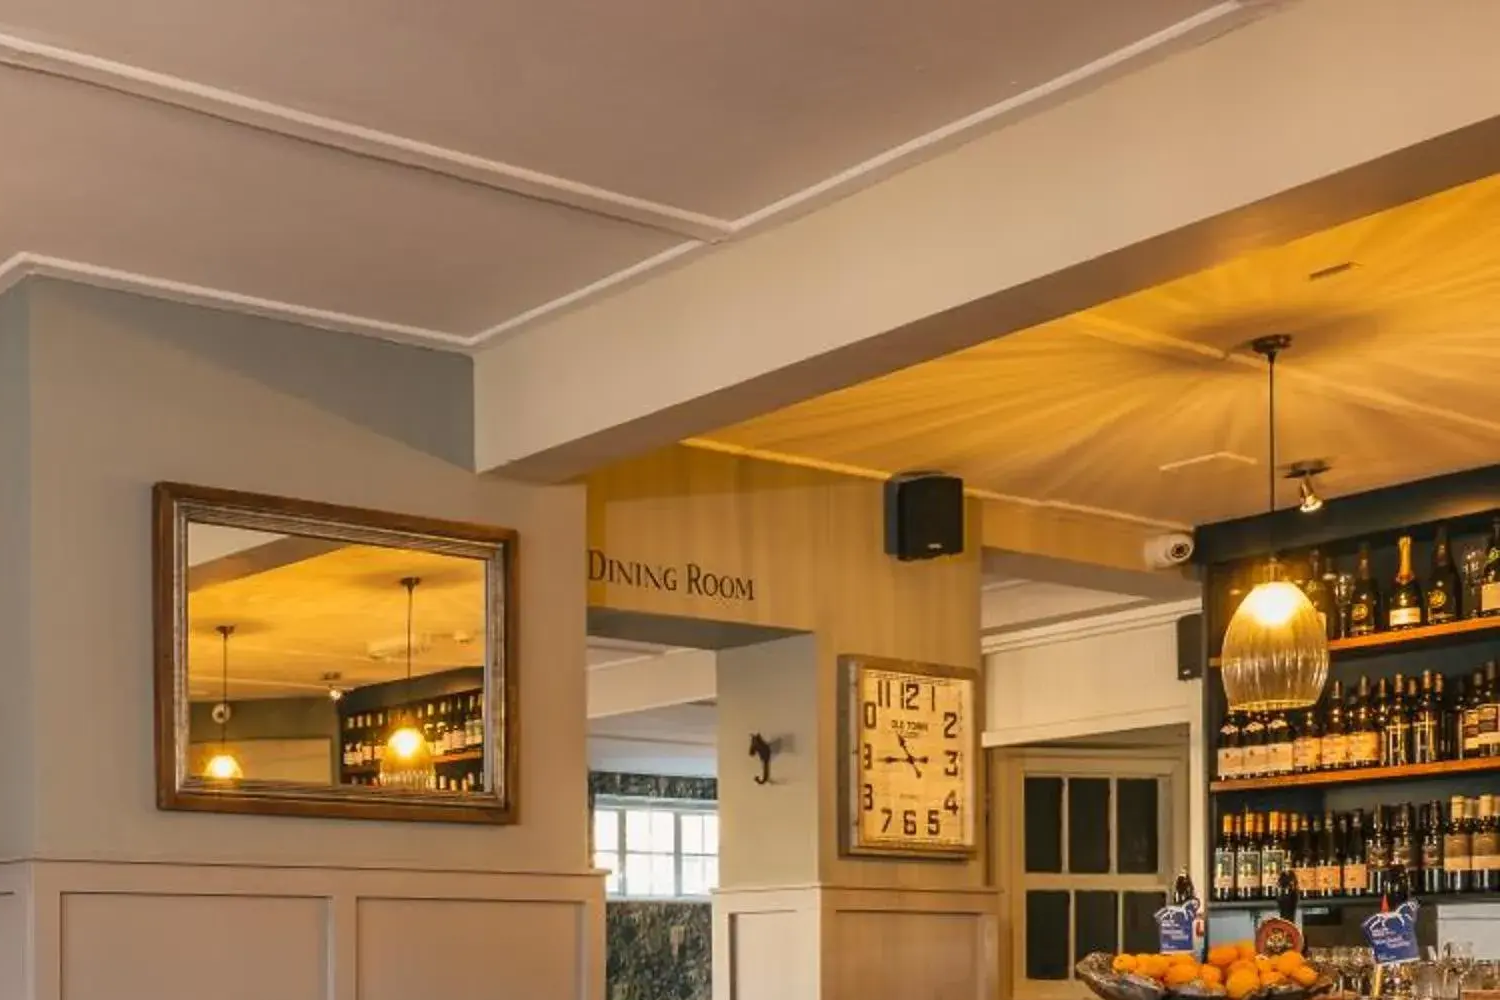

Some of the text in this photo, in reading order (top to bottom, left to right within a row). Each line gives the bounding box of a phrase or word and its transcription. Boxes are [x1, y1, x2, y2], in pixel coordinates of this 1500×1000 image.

[588, 549, 755, 601] DINING ROOM
[877, 680, 891, 708] 11
[901, 682, 920, 710] 12
[943, 711, 958, 739] 2
[943, 750, 959, 777] 3
[943, 789, 959, 815] 4
[880, 808, 940, 836] 7 6 5
